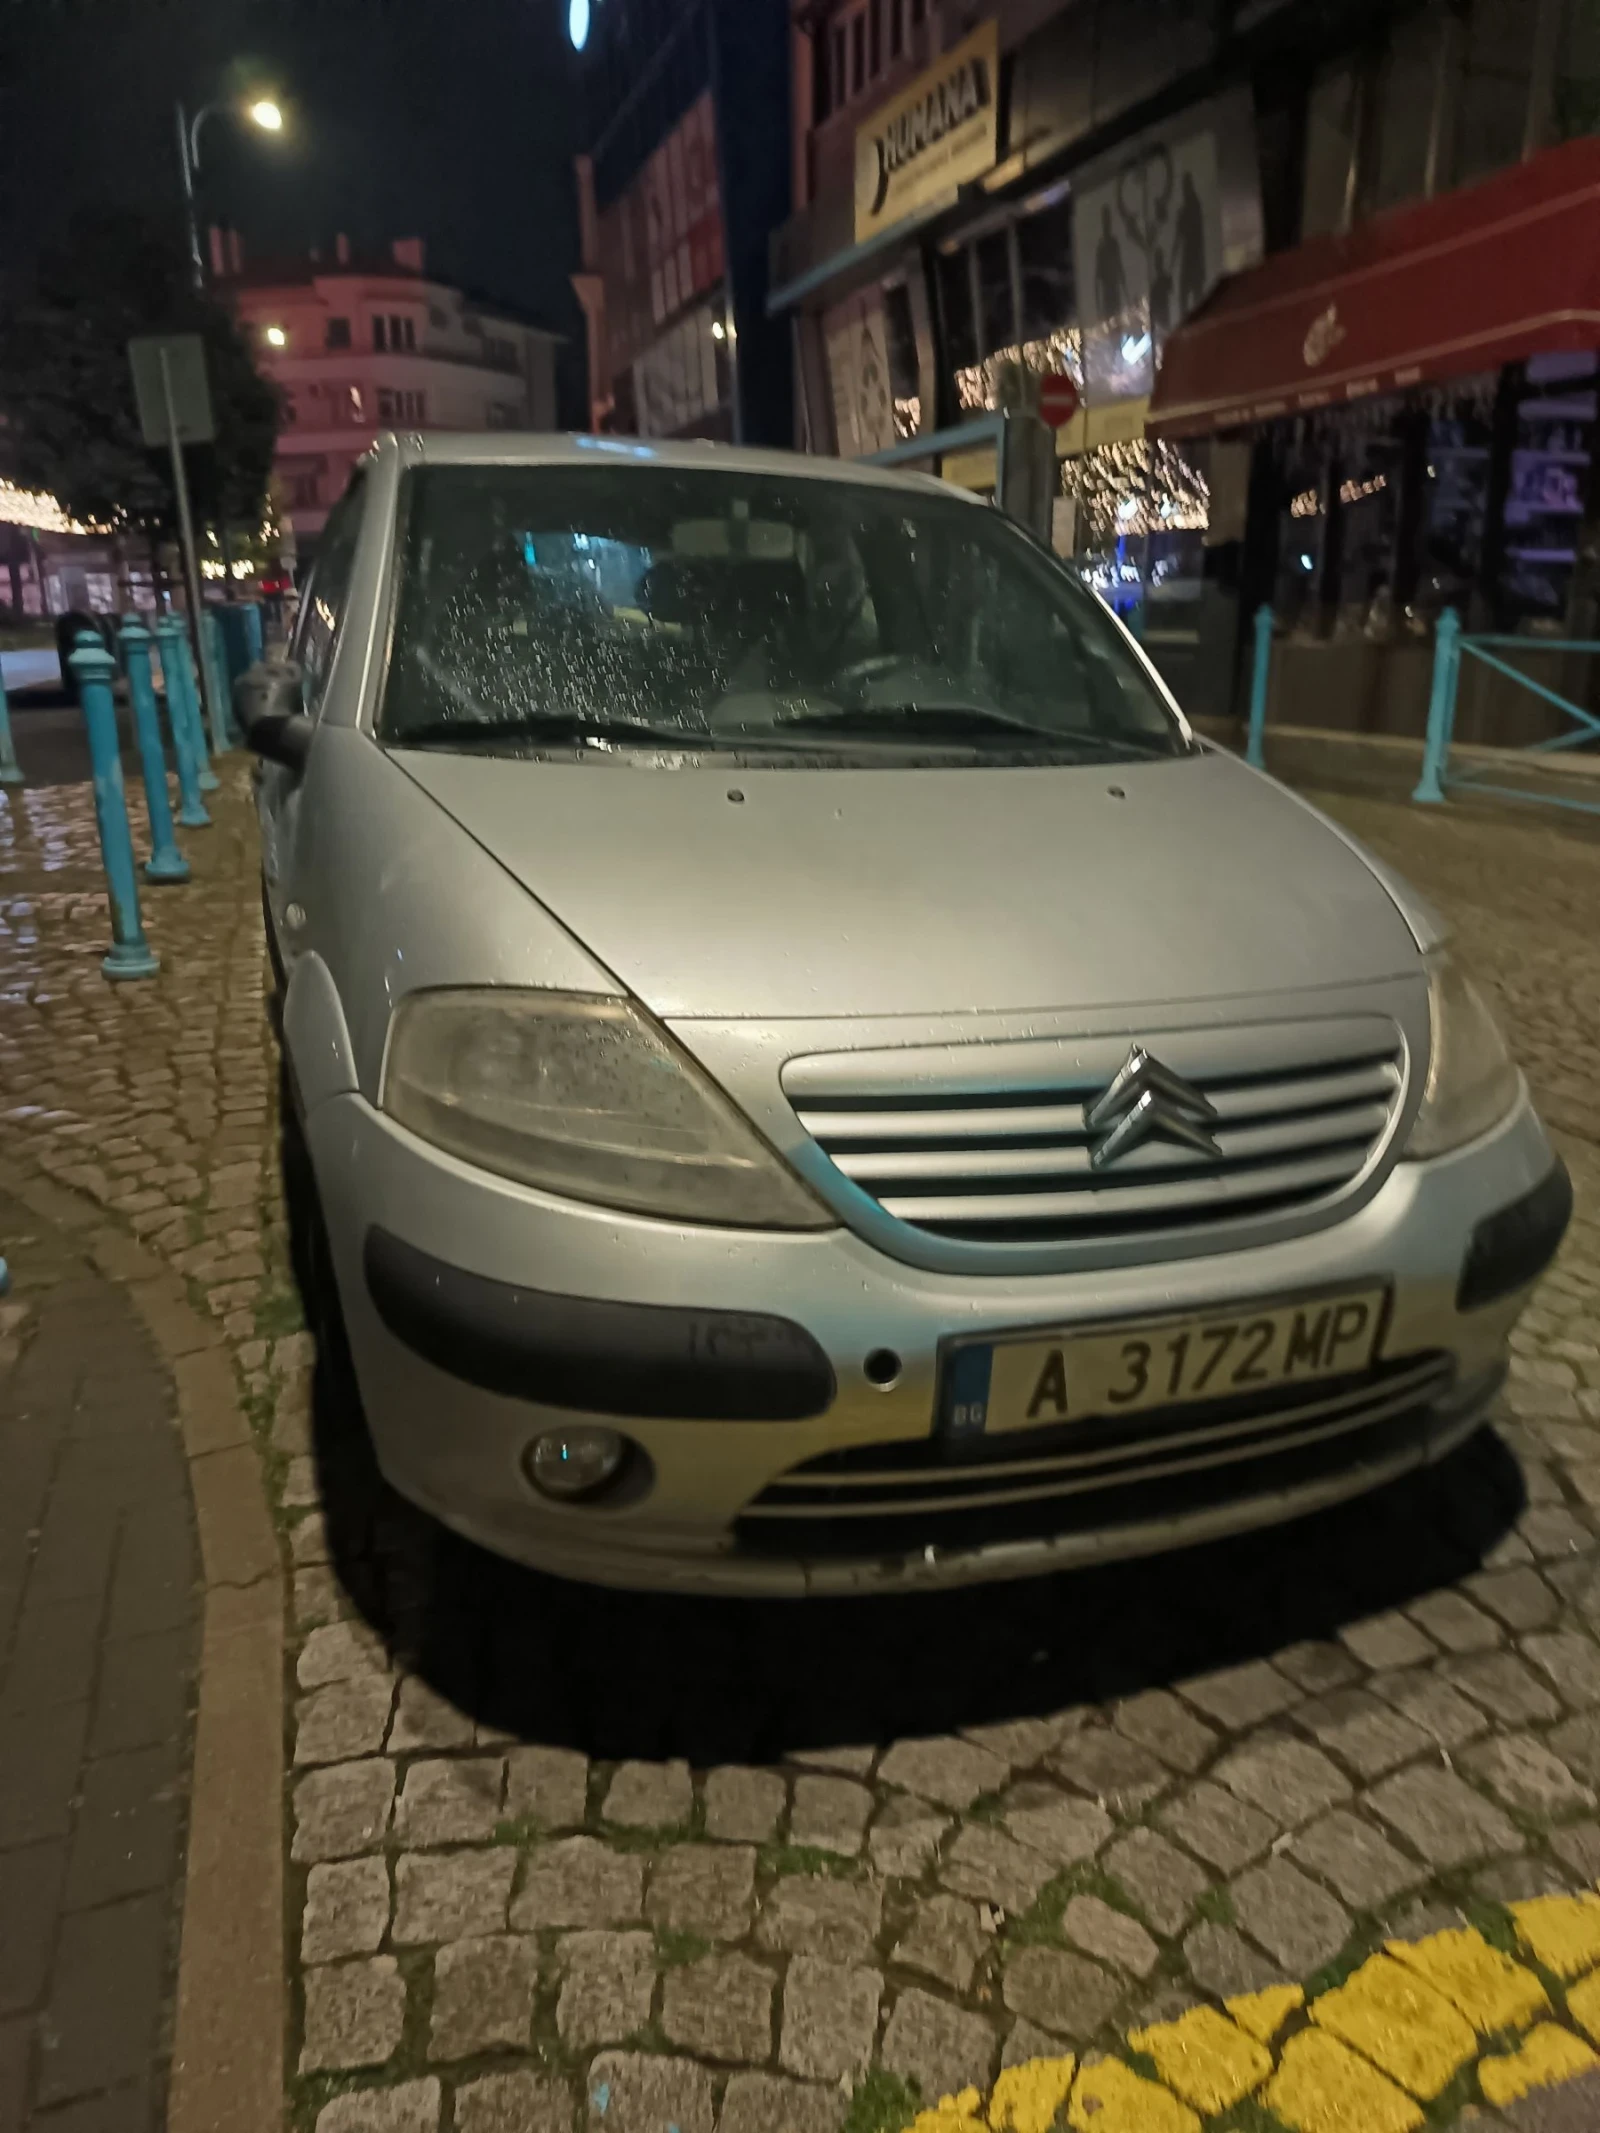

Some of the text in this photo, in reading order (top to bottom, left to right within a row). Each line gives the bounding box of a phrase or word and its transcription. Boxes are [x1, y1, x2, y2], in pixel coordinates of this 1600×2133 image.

[881, 60, 983, 174] HUMANA
[1026, 1302, 1369, 1419] A 3172 MP
